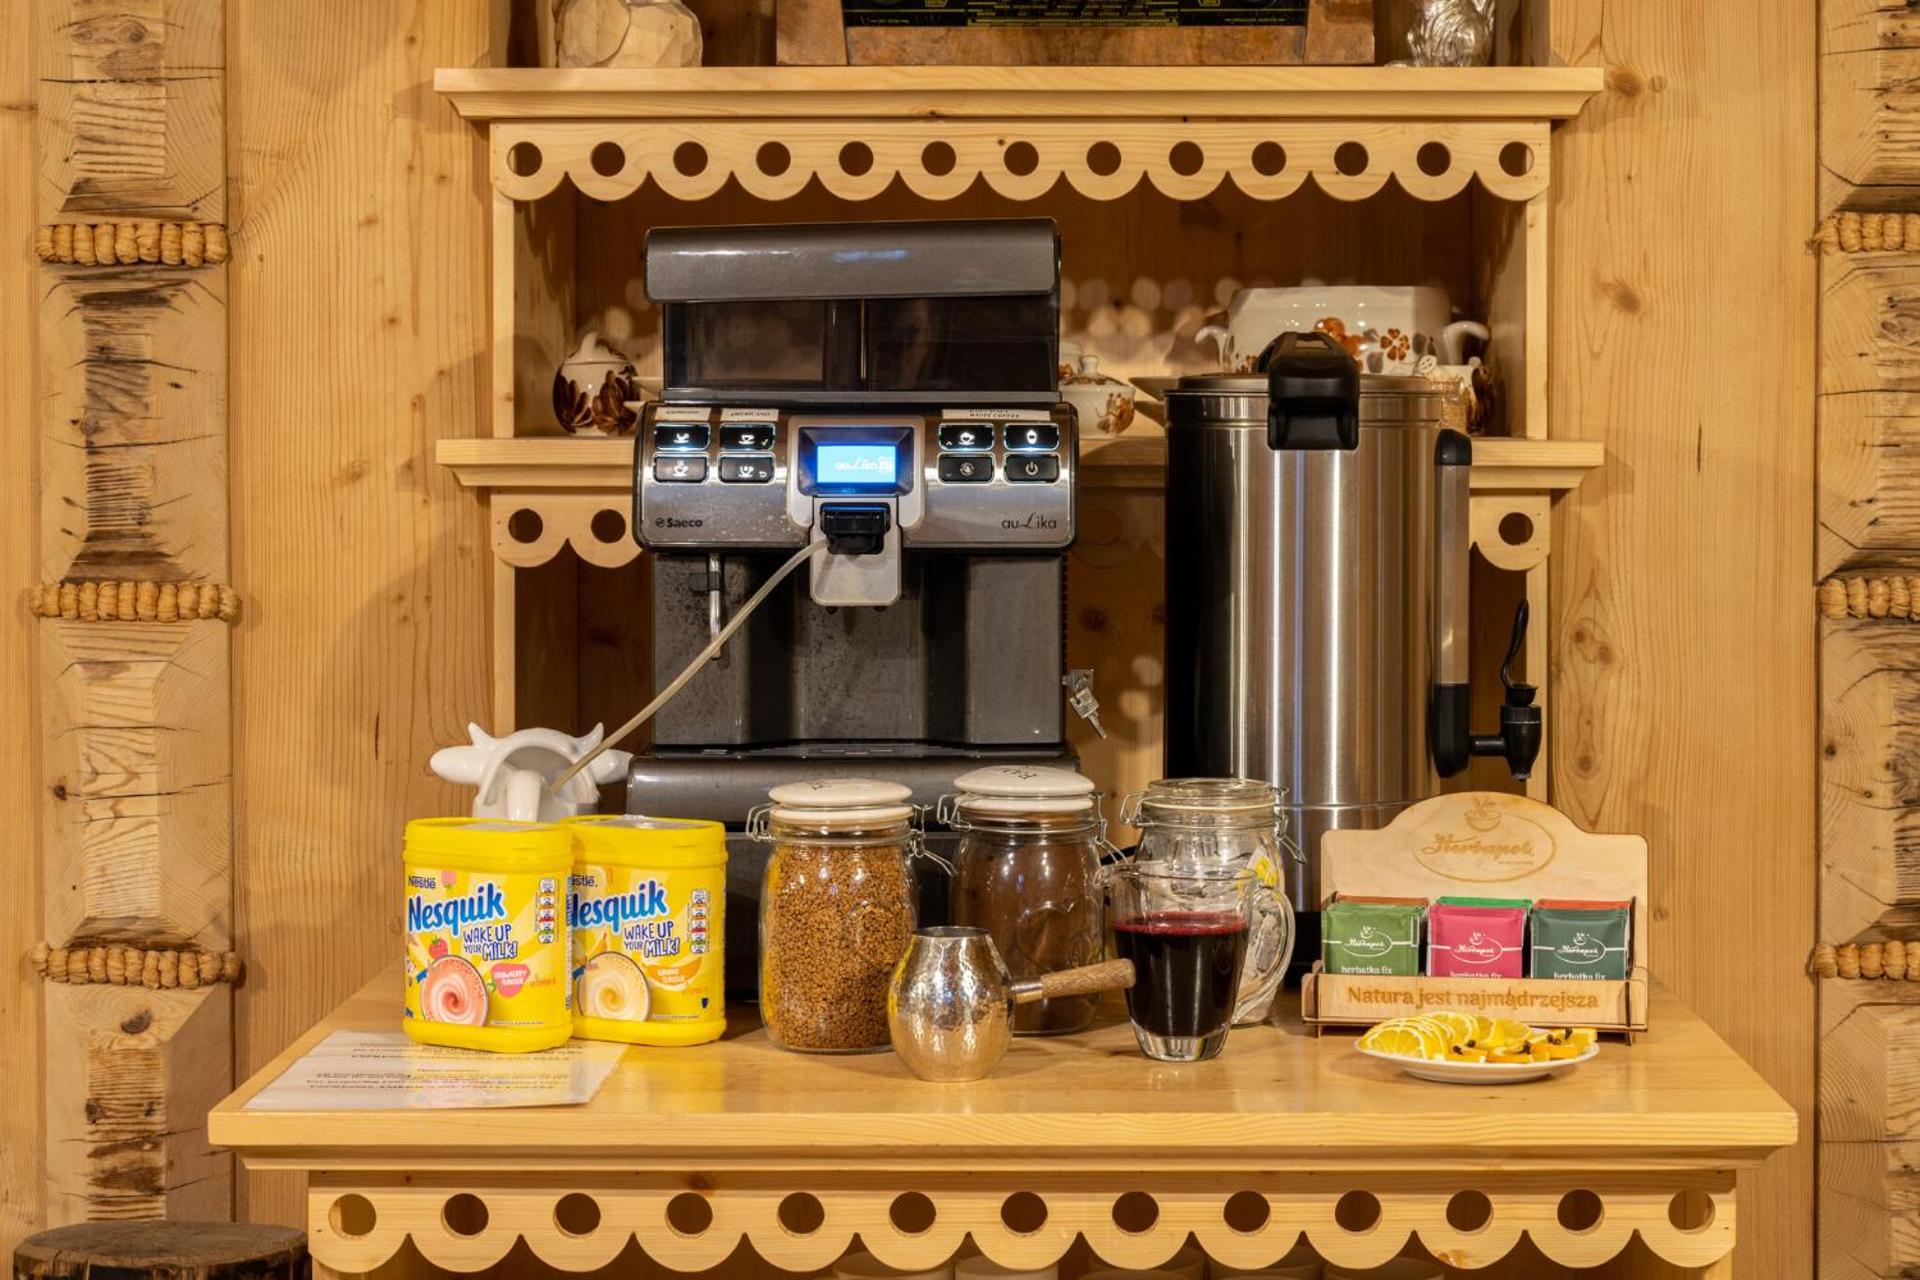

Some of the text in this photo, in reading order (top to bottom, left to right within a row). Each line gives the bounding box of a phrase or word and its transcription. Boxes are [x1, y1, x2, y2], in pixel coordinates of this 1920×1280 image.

[667, 517, 703, 528] Saeco
[408, 882, 505, 937] Nesquik
[463, 924, 512, 944] WAKE UP
[624, 921, 674, 940] WAKE UP
[463, 941, 519, 961] YOUR MILK!
[624, 937, 681, 958] YOUR MILK!
[1340, 965, 1393, 974] herbatka fix
[1348, 986, 1599, 1010] Natura jest najmądrzejsza
